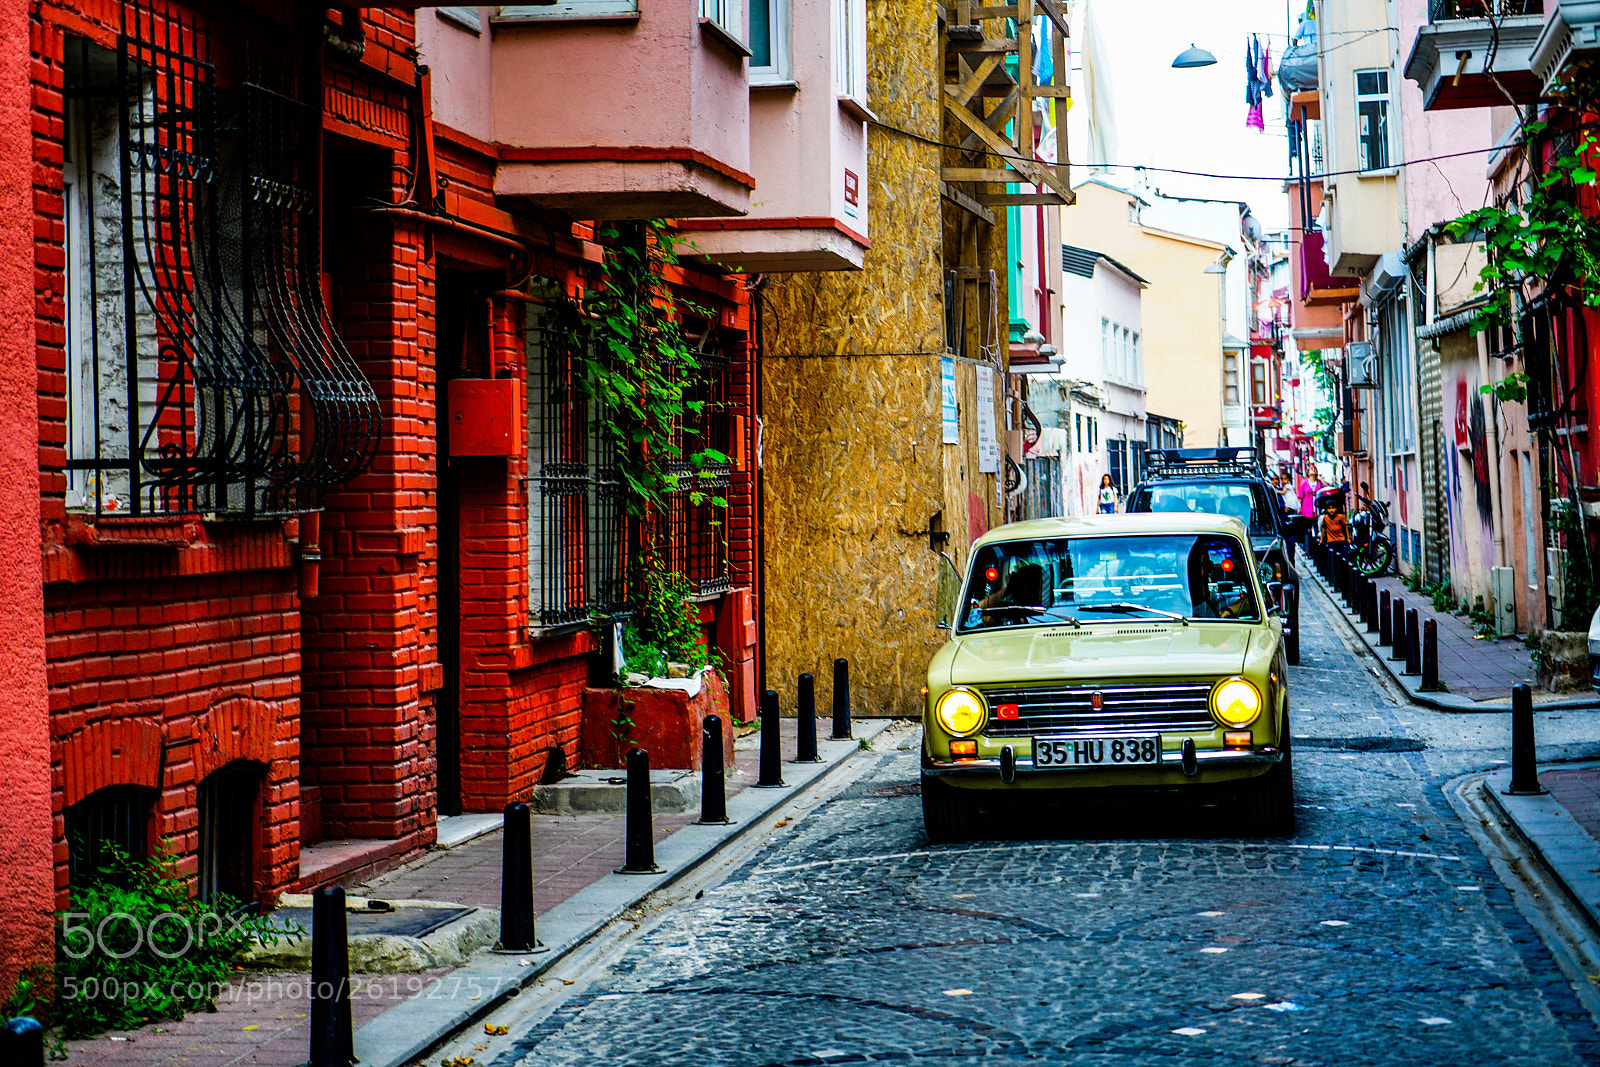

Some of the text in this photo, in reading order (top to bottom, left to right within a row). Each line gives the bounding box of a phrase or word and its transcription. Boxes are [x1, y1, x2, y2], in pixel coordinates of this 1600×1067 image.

[1038, 740, 1156, 764] 35 HU 838
